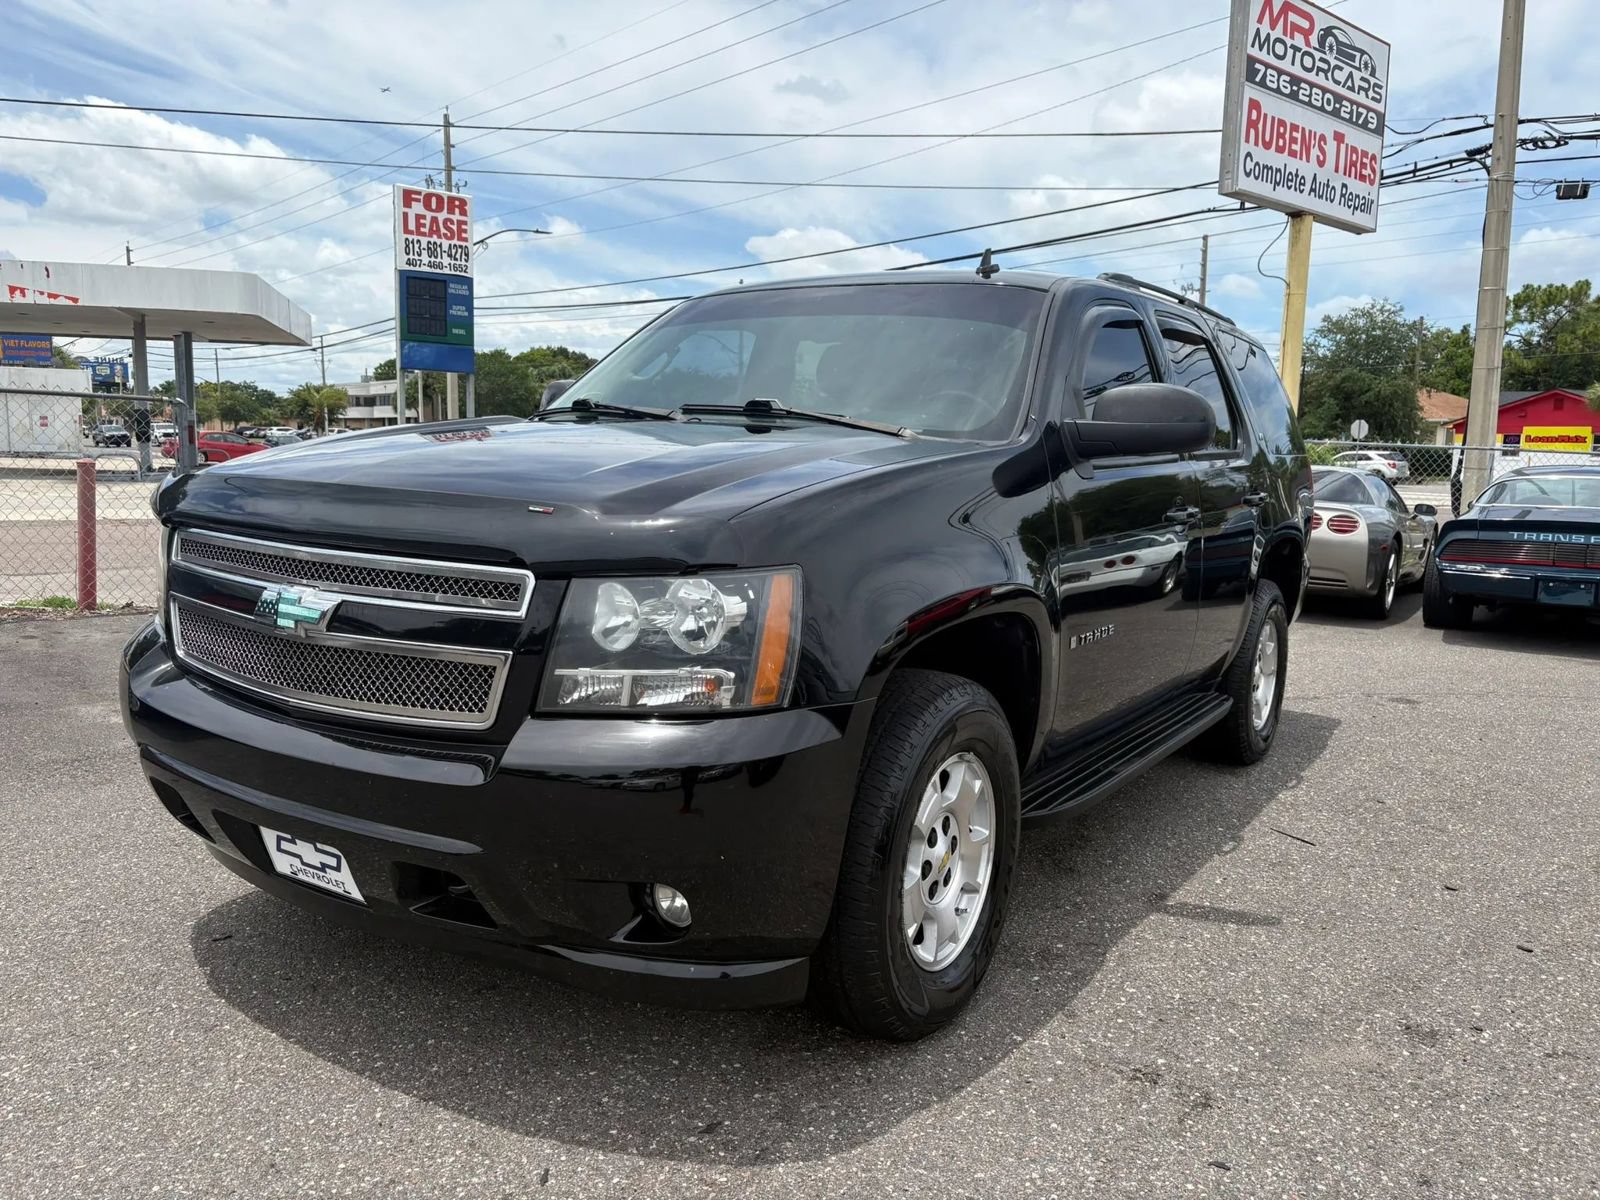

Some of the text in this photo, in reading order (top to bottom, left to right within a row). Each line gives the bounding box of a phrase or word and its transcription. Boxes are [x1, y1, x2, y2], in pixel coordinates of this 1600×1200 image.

[1256, 0, 1315, 48] MR
[1251, 27, 1384, 104] MOTORCARS
[1254, 63, 1378, 130] 786-280-2179
[1333, 130, 1377, 187] TIRES
[1243, 151, 1375, 216] Complete Auto Repair
[402, 188, 468, 217] FOR
[402, 211, 469, 242] LEASE
[404, 237, 470, 263] 813-681-4279
[405, 256, 469, 274] 407-460-1652
[20, 340, 50, 348] FLAVORS
[1525, 434, 1587, 444] LoanMax
[1508, 531, 1585, 543] TRANS
[1079, 624, 1115, 646] TAHOE
[289, 863, 346, 890] CHEVROLET
